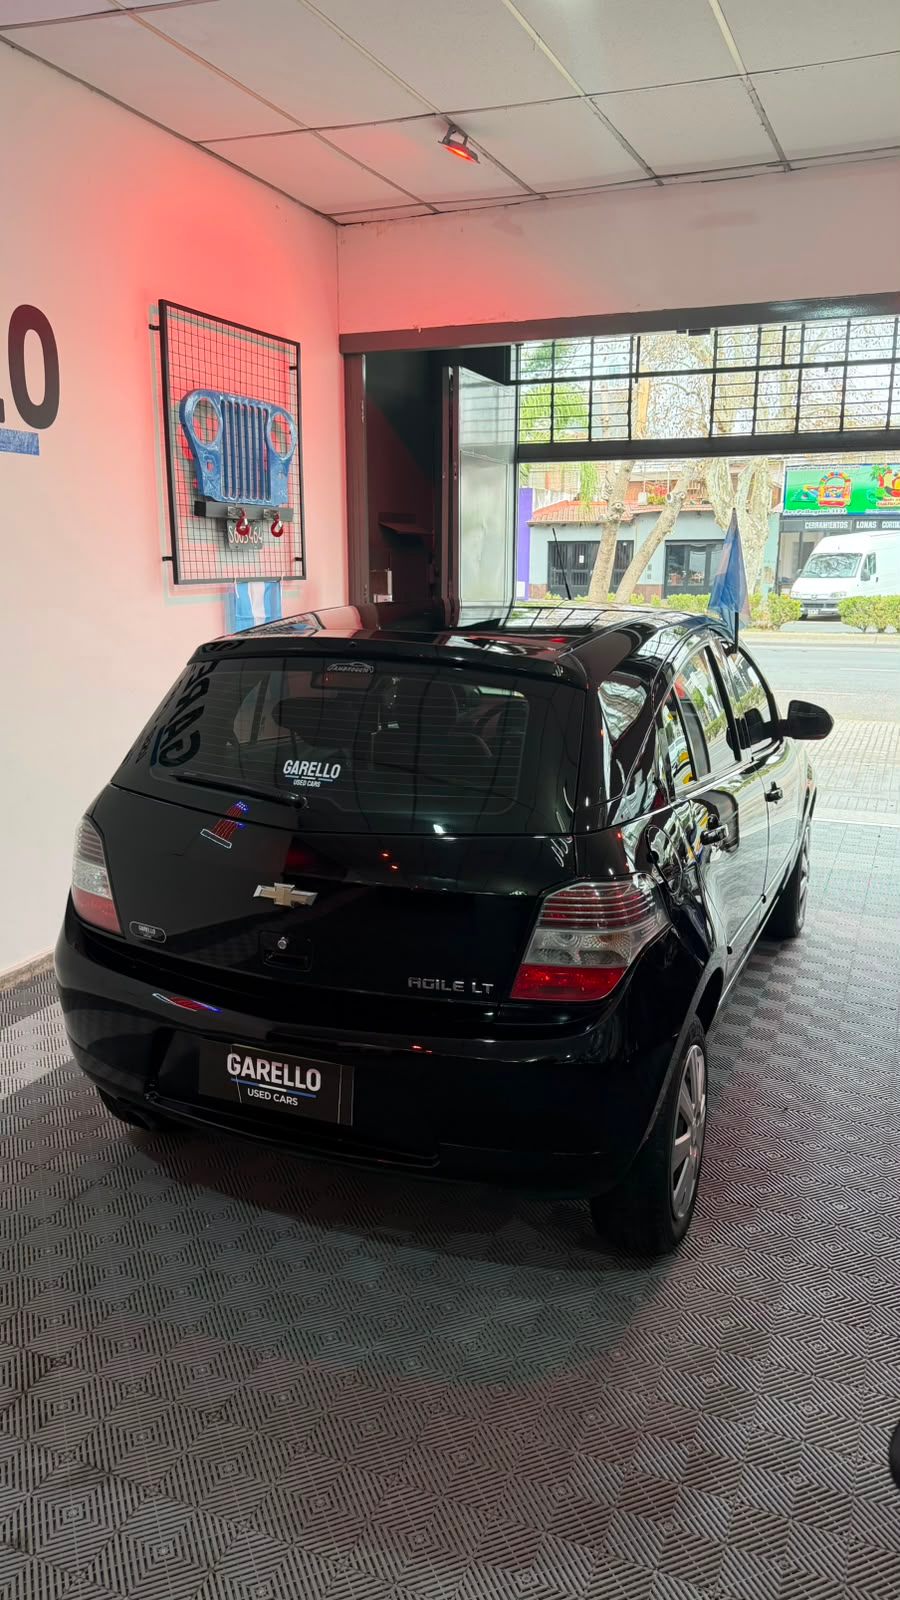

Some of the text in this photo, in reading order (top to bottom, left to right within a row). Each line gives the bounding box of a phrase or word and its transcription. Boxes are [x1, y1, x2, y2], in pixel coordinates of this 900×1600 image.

[804, 521, 849, 529] CERRAMIENTOS
[856, 521, 877, 529] LONAS
[283, 760, 341, 779] GARELLO
[307, 780, 321, 788] CARS
[408, 976, 494, 994] AGILE LT
[226, 1052, 321, 1092] GARELLO
[247, 1087, 299, 1106] USED CARS
